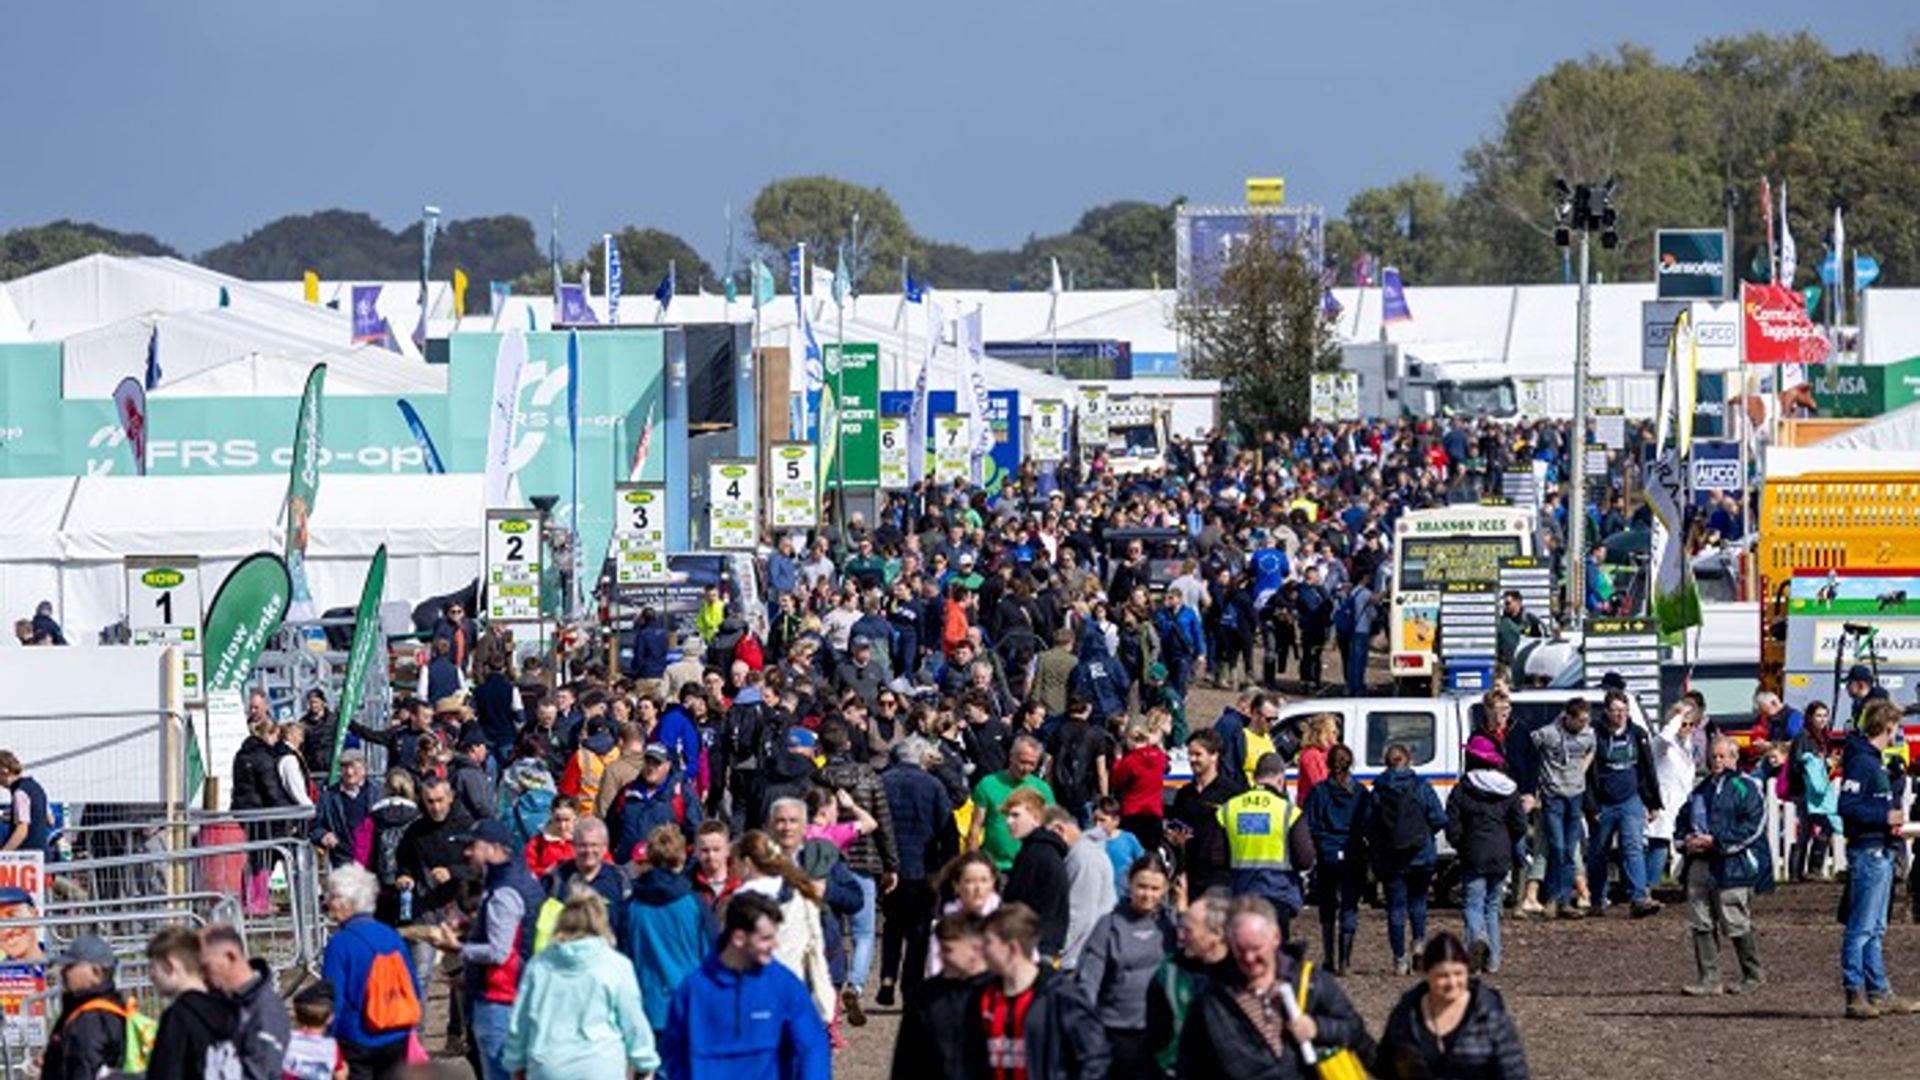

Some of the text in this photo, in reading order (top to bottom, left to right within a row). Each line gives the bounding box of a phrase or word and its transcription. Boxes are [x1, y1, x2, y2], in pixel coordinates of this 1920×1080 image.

[882, 431, 895, 448] 6
[947, 430, 958, 446] 7
[147, 439, 424, 473] FRS co-op
[787, 461, 799, 480] 5
[726, 480, 741, 500] 4
[633, 506, 648, 529] 3
[507, 535, 524, 561] 2
[145, 574, 180, 584] ROW
[156, 590, 172, 624] 1
[246, 593, 281, 652] Tanks
